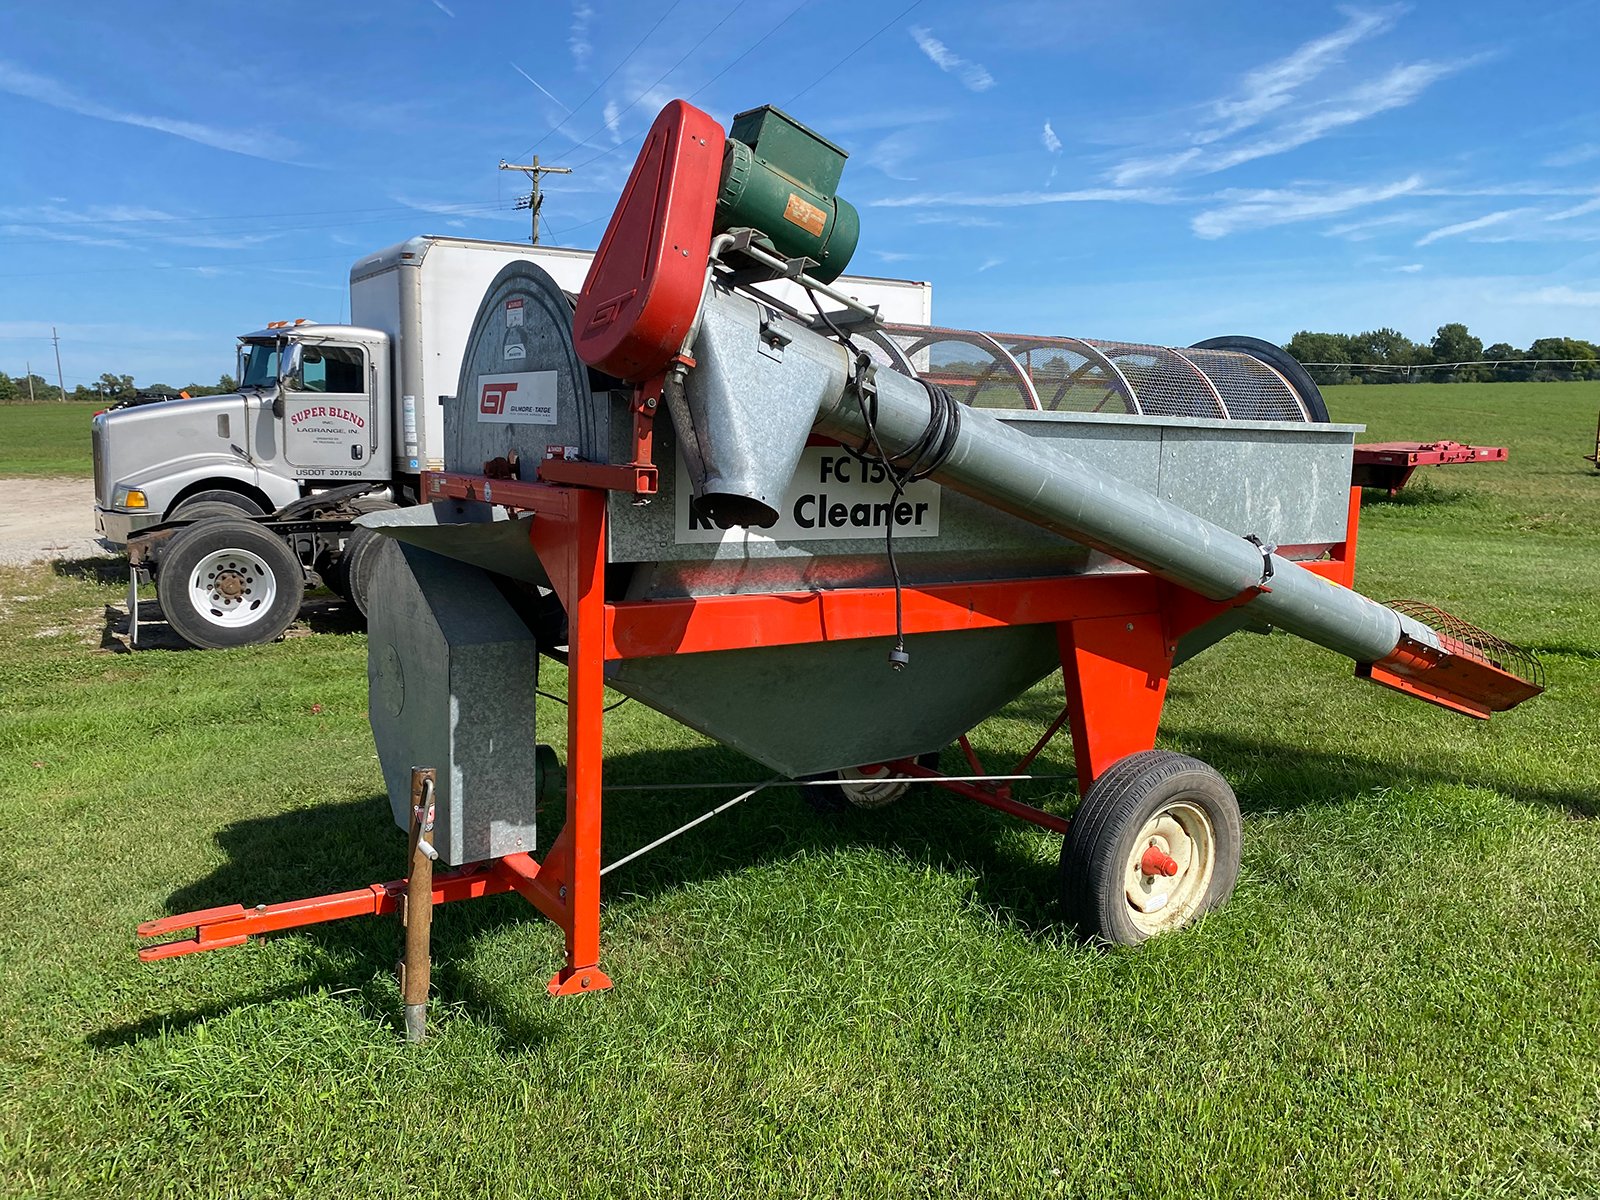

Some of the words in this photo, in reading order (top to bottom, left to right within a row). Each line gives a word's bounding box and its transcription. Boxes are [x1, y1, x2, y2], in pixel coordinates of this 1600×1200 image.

[480, 382, 518, 415] GT
[290, 406, 326, 425] SUPER
[329, 406, 365, 428] BLEND
[329, 469, 362, 477] 3077560
[820, 456, 850, 483] FC
[860, 457, 903, 483] 15
[793, 494, 929, 528] Cleaner
